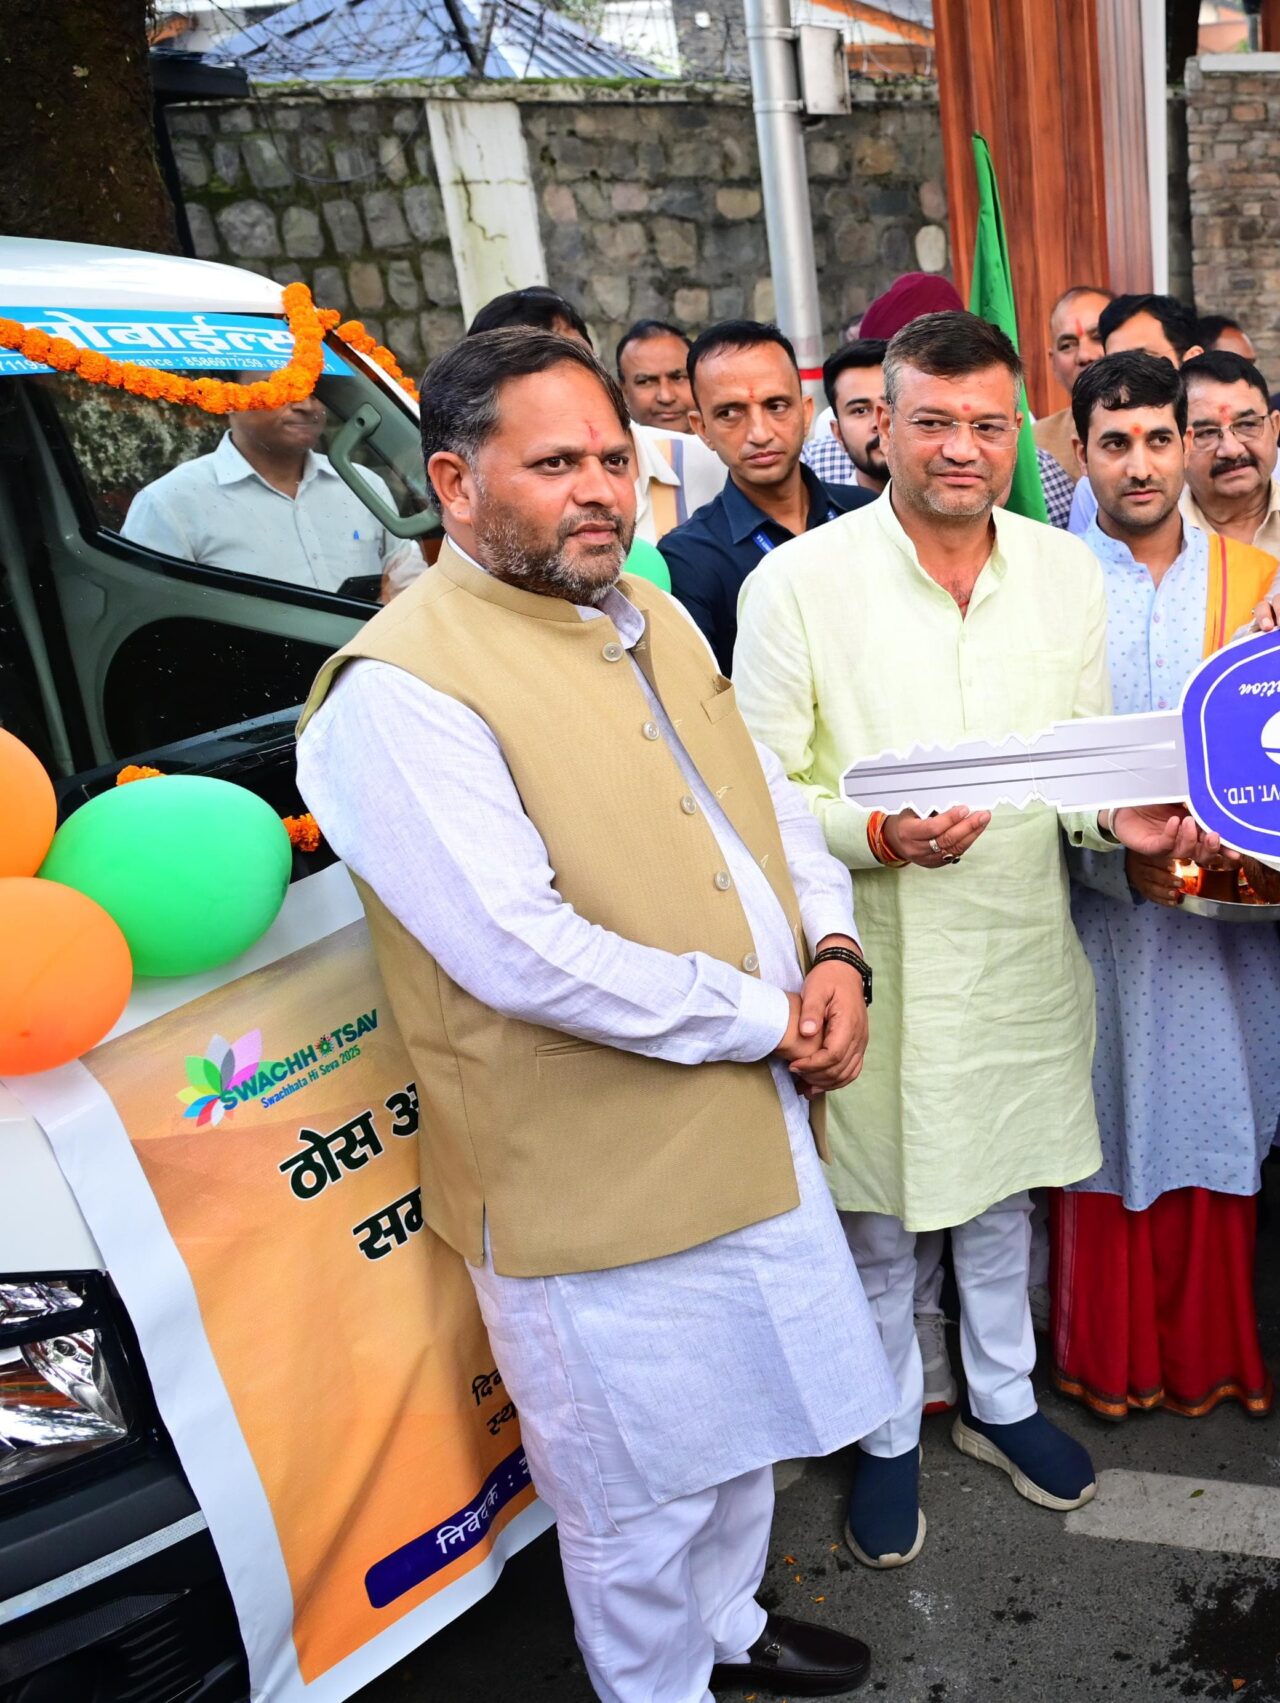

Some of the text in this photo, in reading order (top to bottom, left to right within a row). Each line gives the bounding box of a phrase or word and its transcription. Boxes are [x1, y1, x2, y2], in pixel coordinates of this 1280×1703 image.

[1223, 785, 1255, 805] LTD.
[261, 1044, 362, 1109] Swachhata Hi Seva 2025
[279, 1109, 384, 1199] ठोस
[436, 1483, 498, 1554] निवेदक
